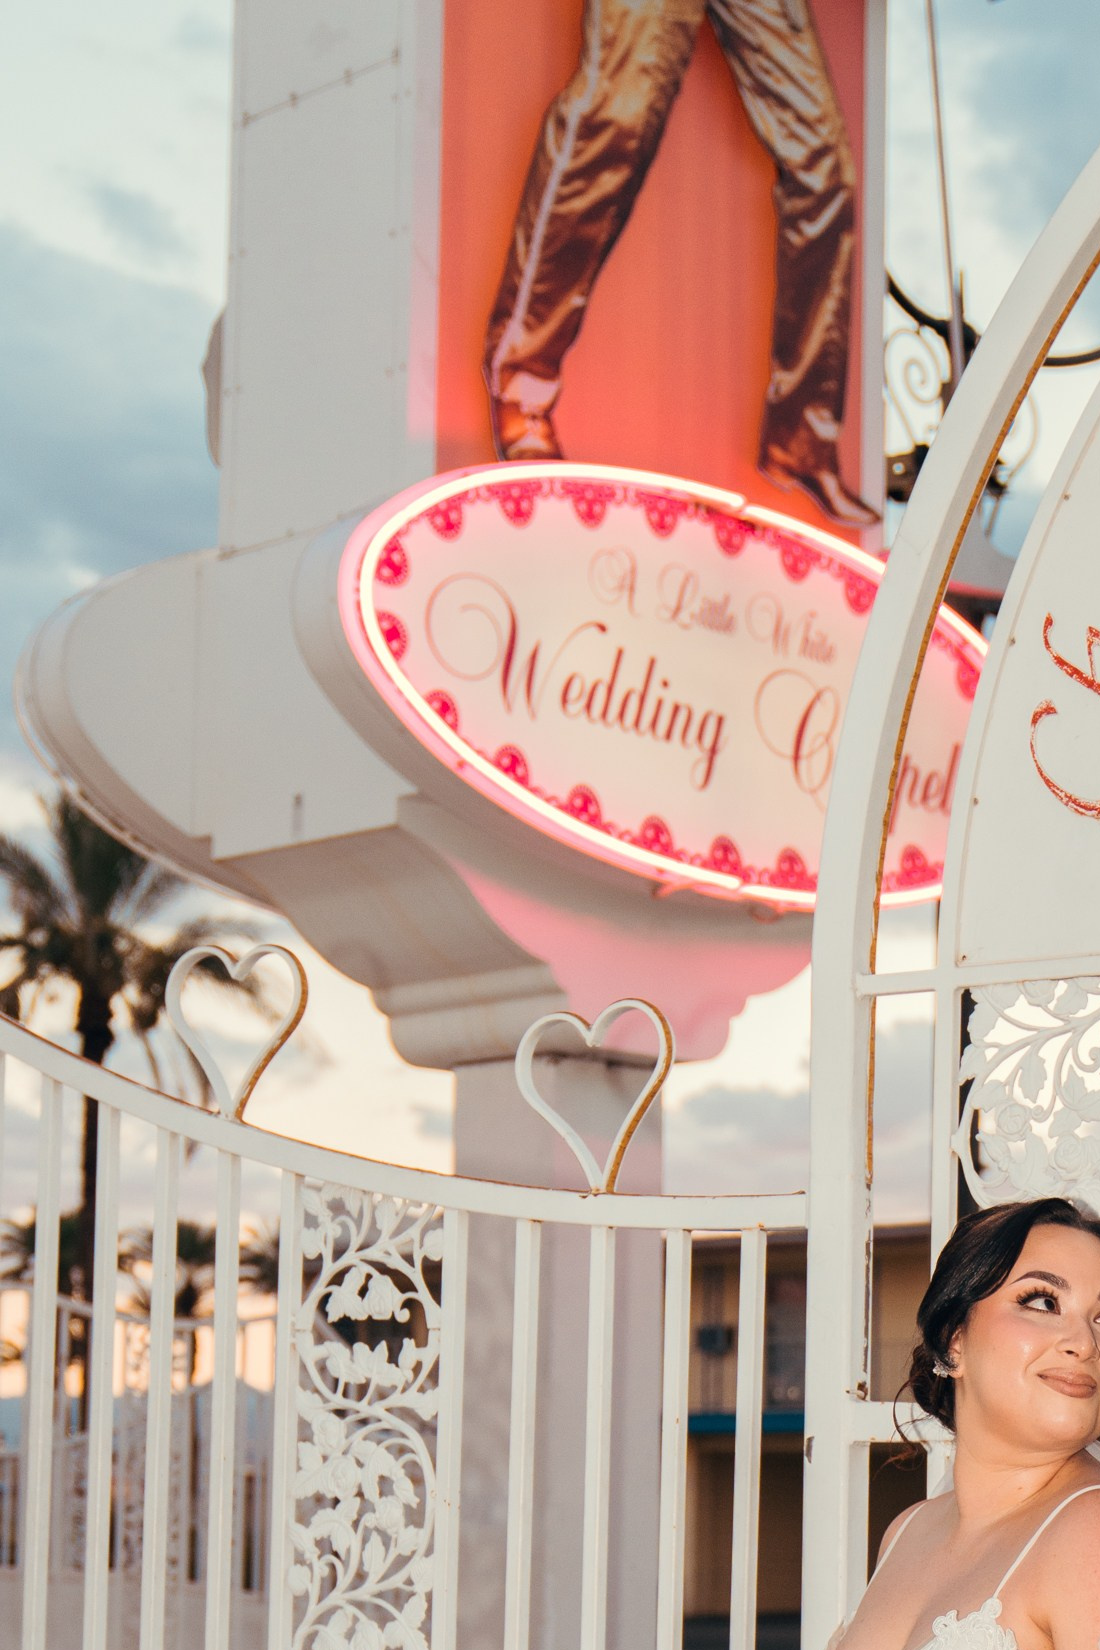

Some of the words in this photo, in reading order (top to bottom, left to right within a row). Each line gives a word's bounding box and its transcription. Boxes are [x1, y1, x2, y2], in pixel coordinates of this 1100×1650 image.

[586, 545, 638, 618] A
[425, 572, 727, 790] Wedding
[754, 668, 960, 836] Cpel
